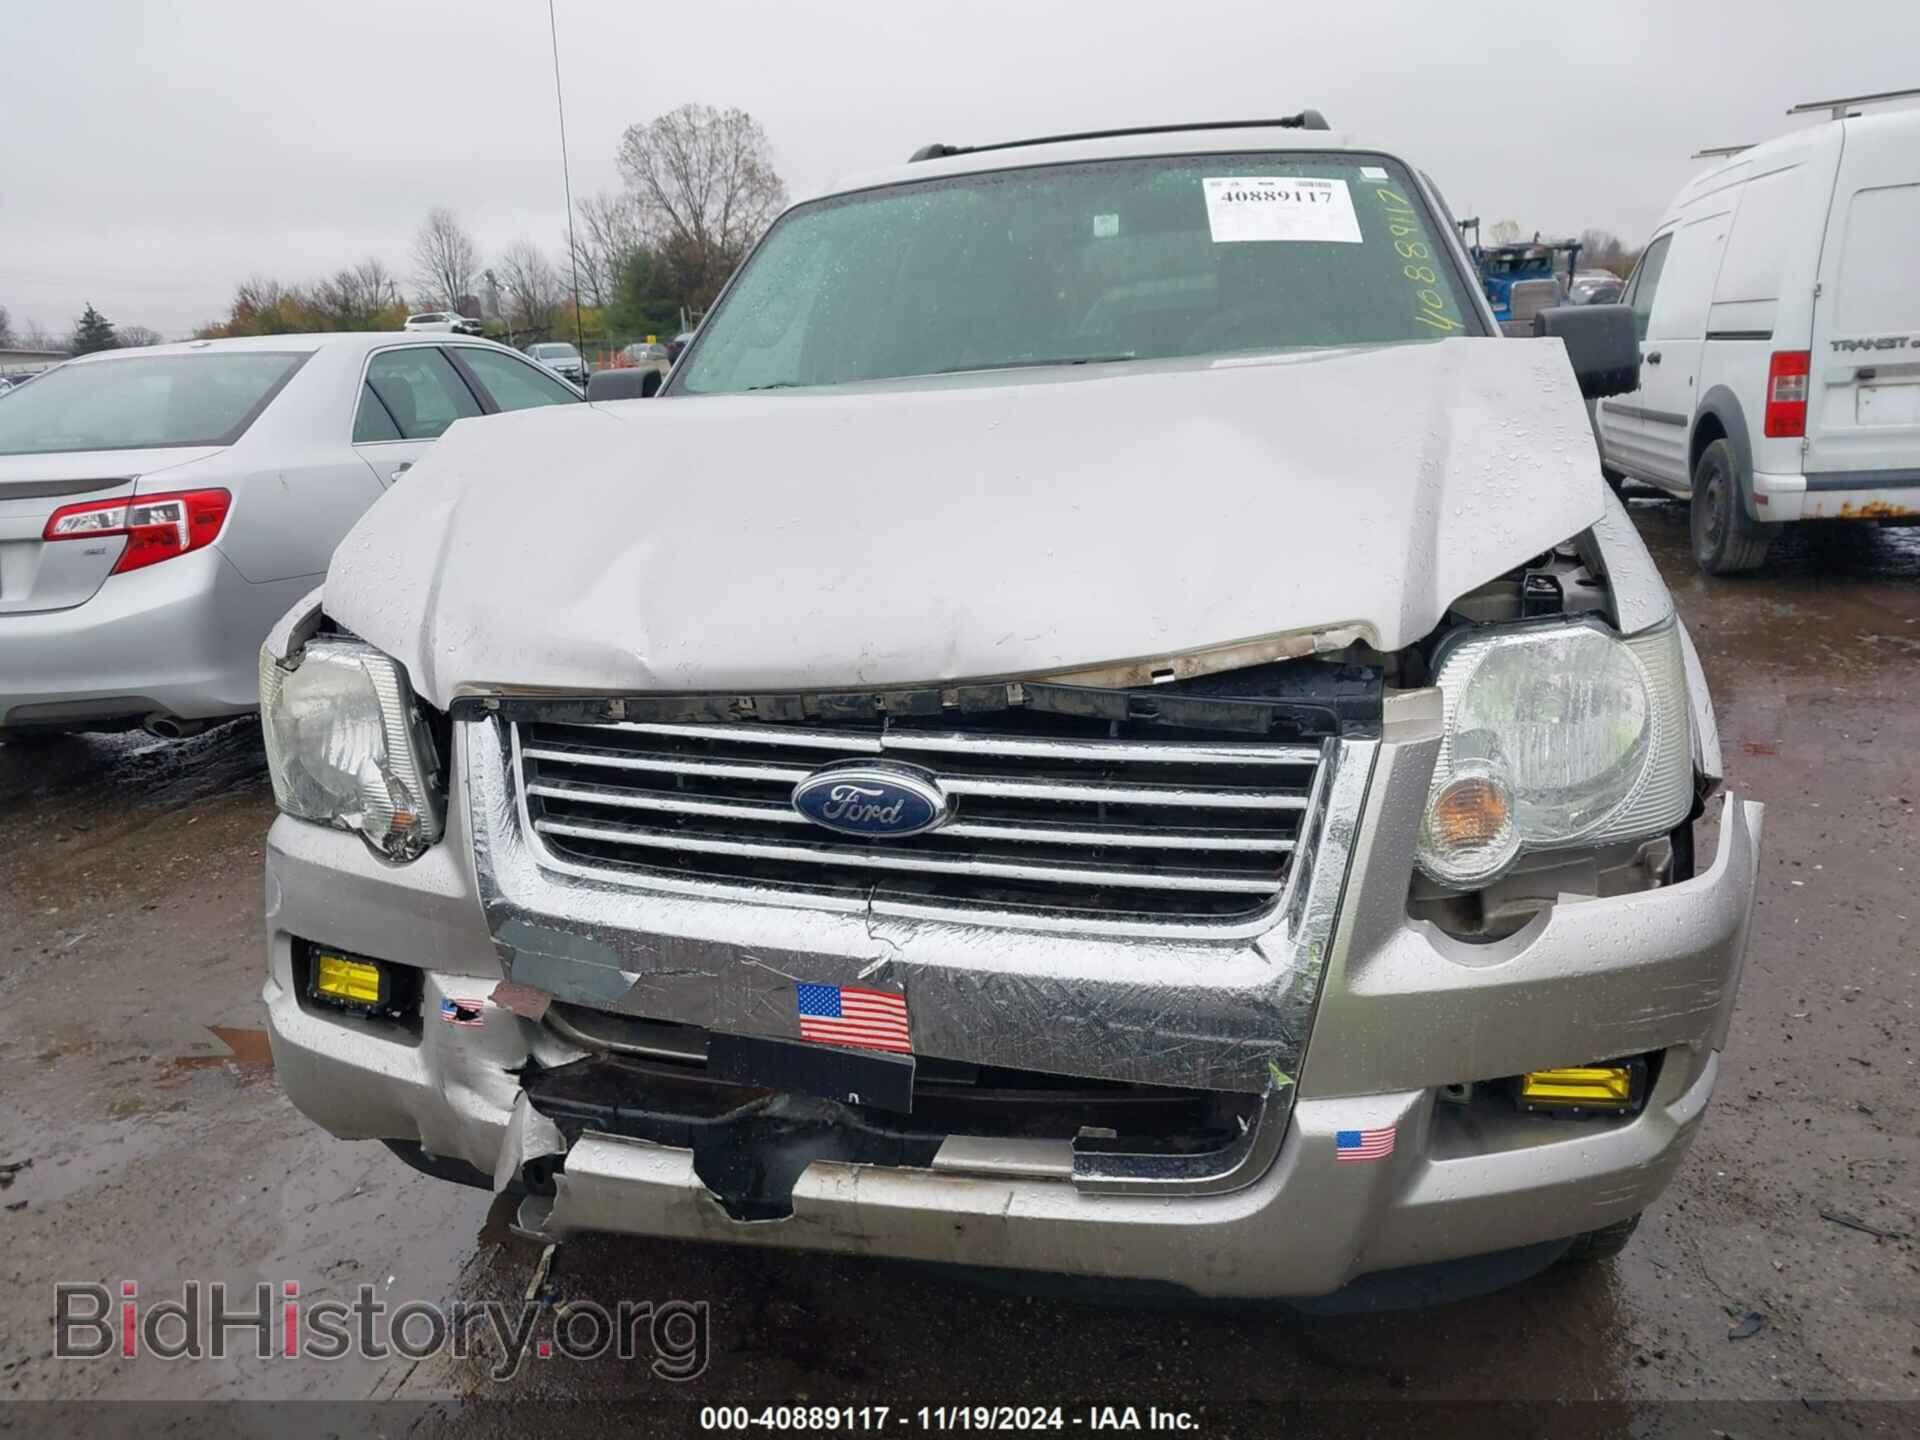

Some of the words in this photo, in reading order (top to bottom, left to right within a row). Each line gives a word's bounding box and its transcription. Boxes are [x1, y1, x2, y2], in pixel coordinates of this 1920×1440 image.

[1221, 190, 1332, 203] 40889117
[1376, 188, 1465, 330] 40889117
[1830, 336, 1909, 352] TRANSIT
[823, 784, 905, 824] Ford
